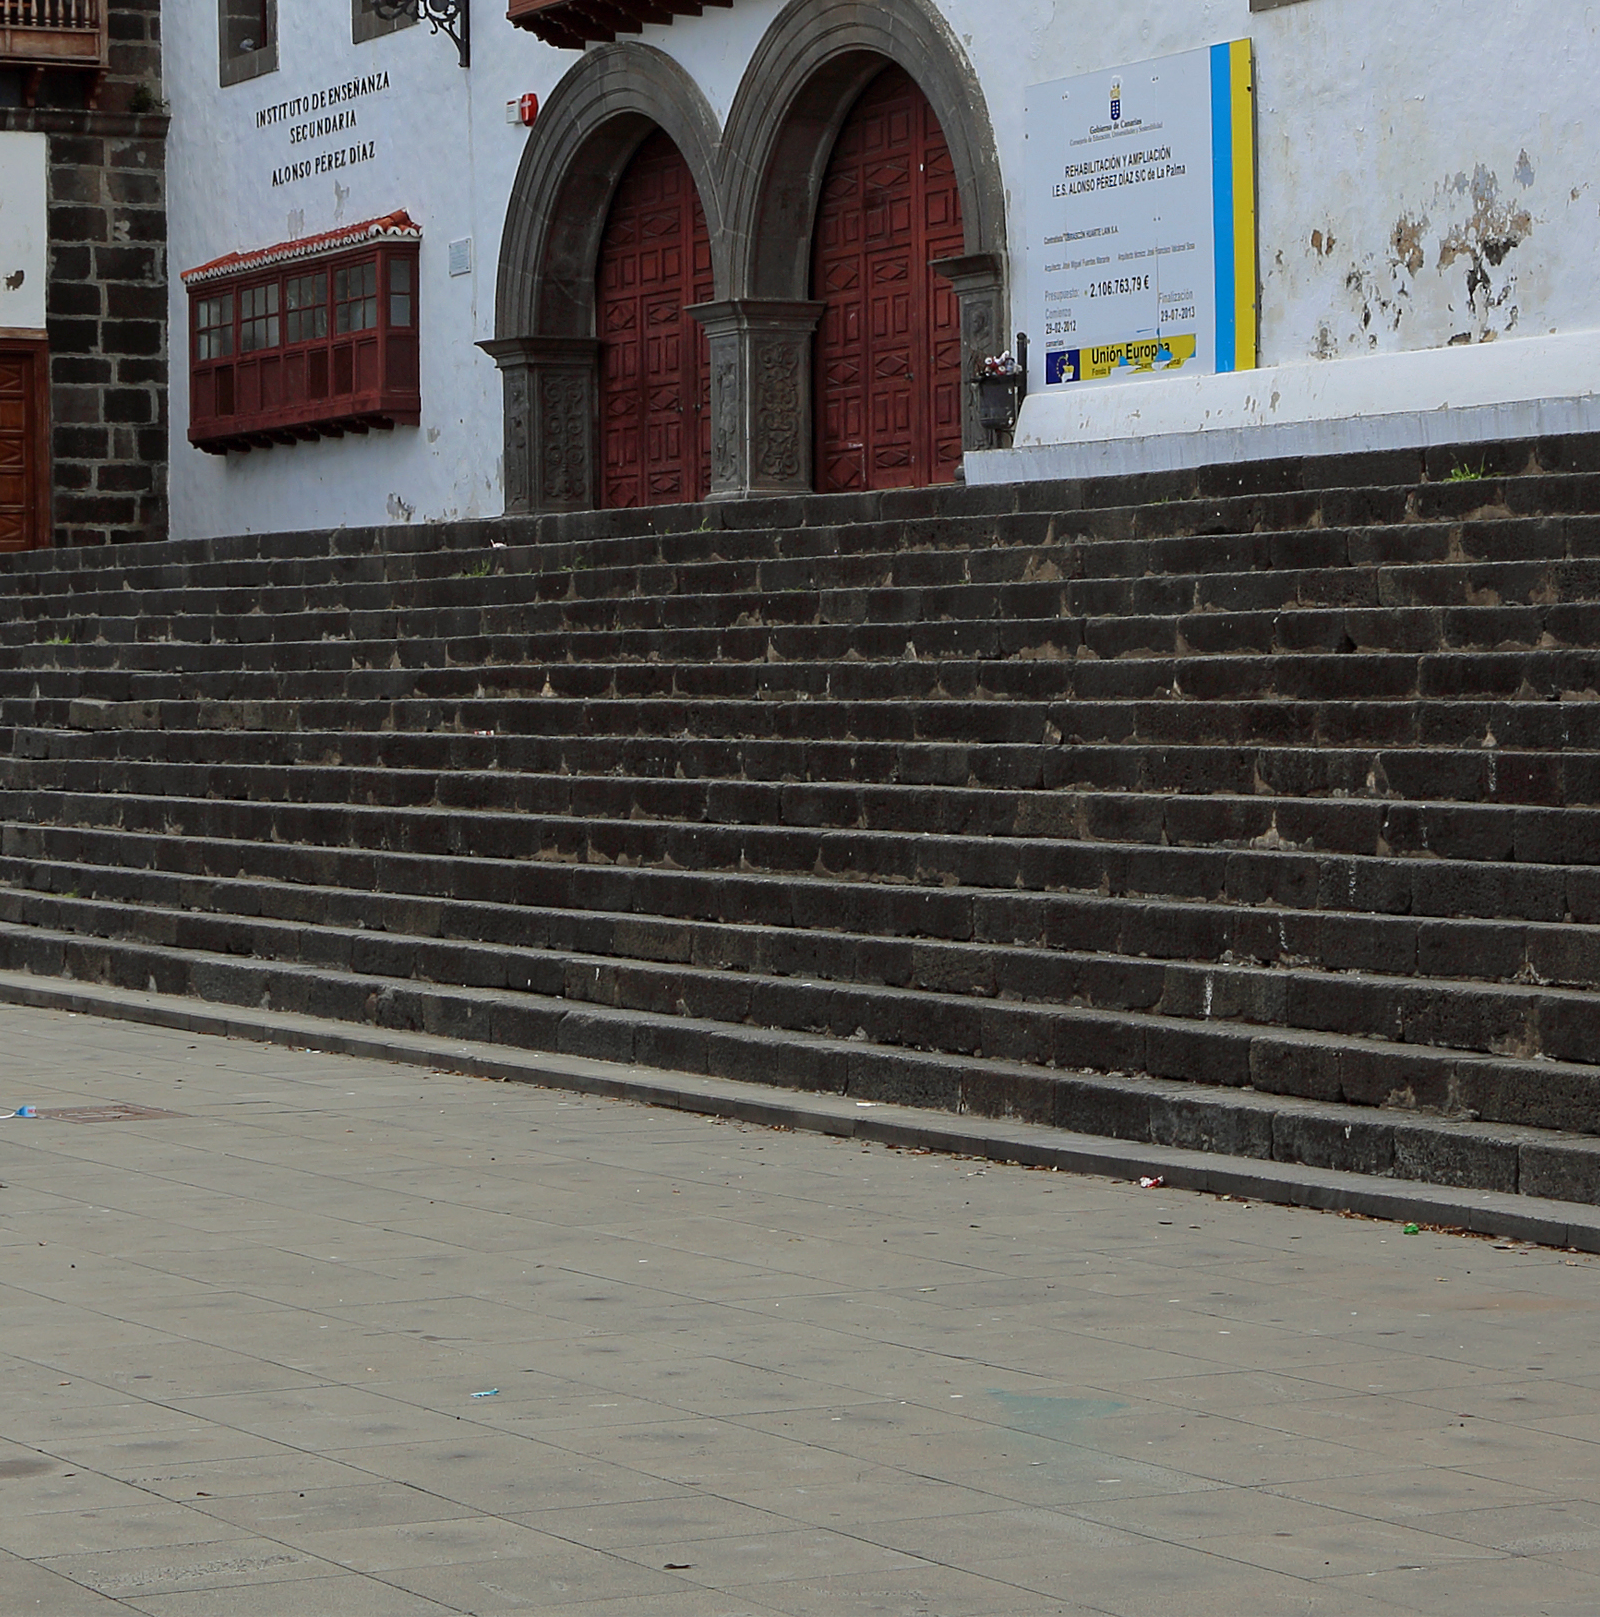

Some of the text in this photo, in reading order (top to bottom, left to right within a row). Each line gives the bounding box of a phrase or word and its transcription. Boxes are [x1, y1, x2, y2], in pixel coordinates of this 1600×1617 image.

[255, 70, 390, 129] INSTITUTO DE ENSEÑANZA
[290, 110, 357, 144] SECUNDARIA
[1089, 118, 1142, 134] Gobierno de Canarias
[272, 140, 375, 187] ALONSO PÉREZ DÍAZ
[1065, 145, 1172, 178] REHABILITACIÓN Y AMPLIACIÓN
[1052, 163, 1186, 198] I.E.S. ALONSO PÉREZ DÍAZ S/C de La Palma
[1090, 276, 1142, 297] 2.106.763,79
[1143, 275, 1150, 289] €
[1159, 289, 1193, 303] Finalización
[1045, 307, 1072, 319] Comienzo
[1160, 307, 1195, 322] 29-07-2013
[1091, 345, 1123, 365] Unión
